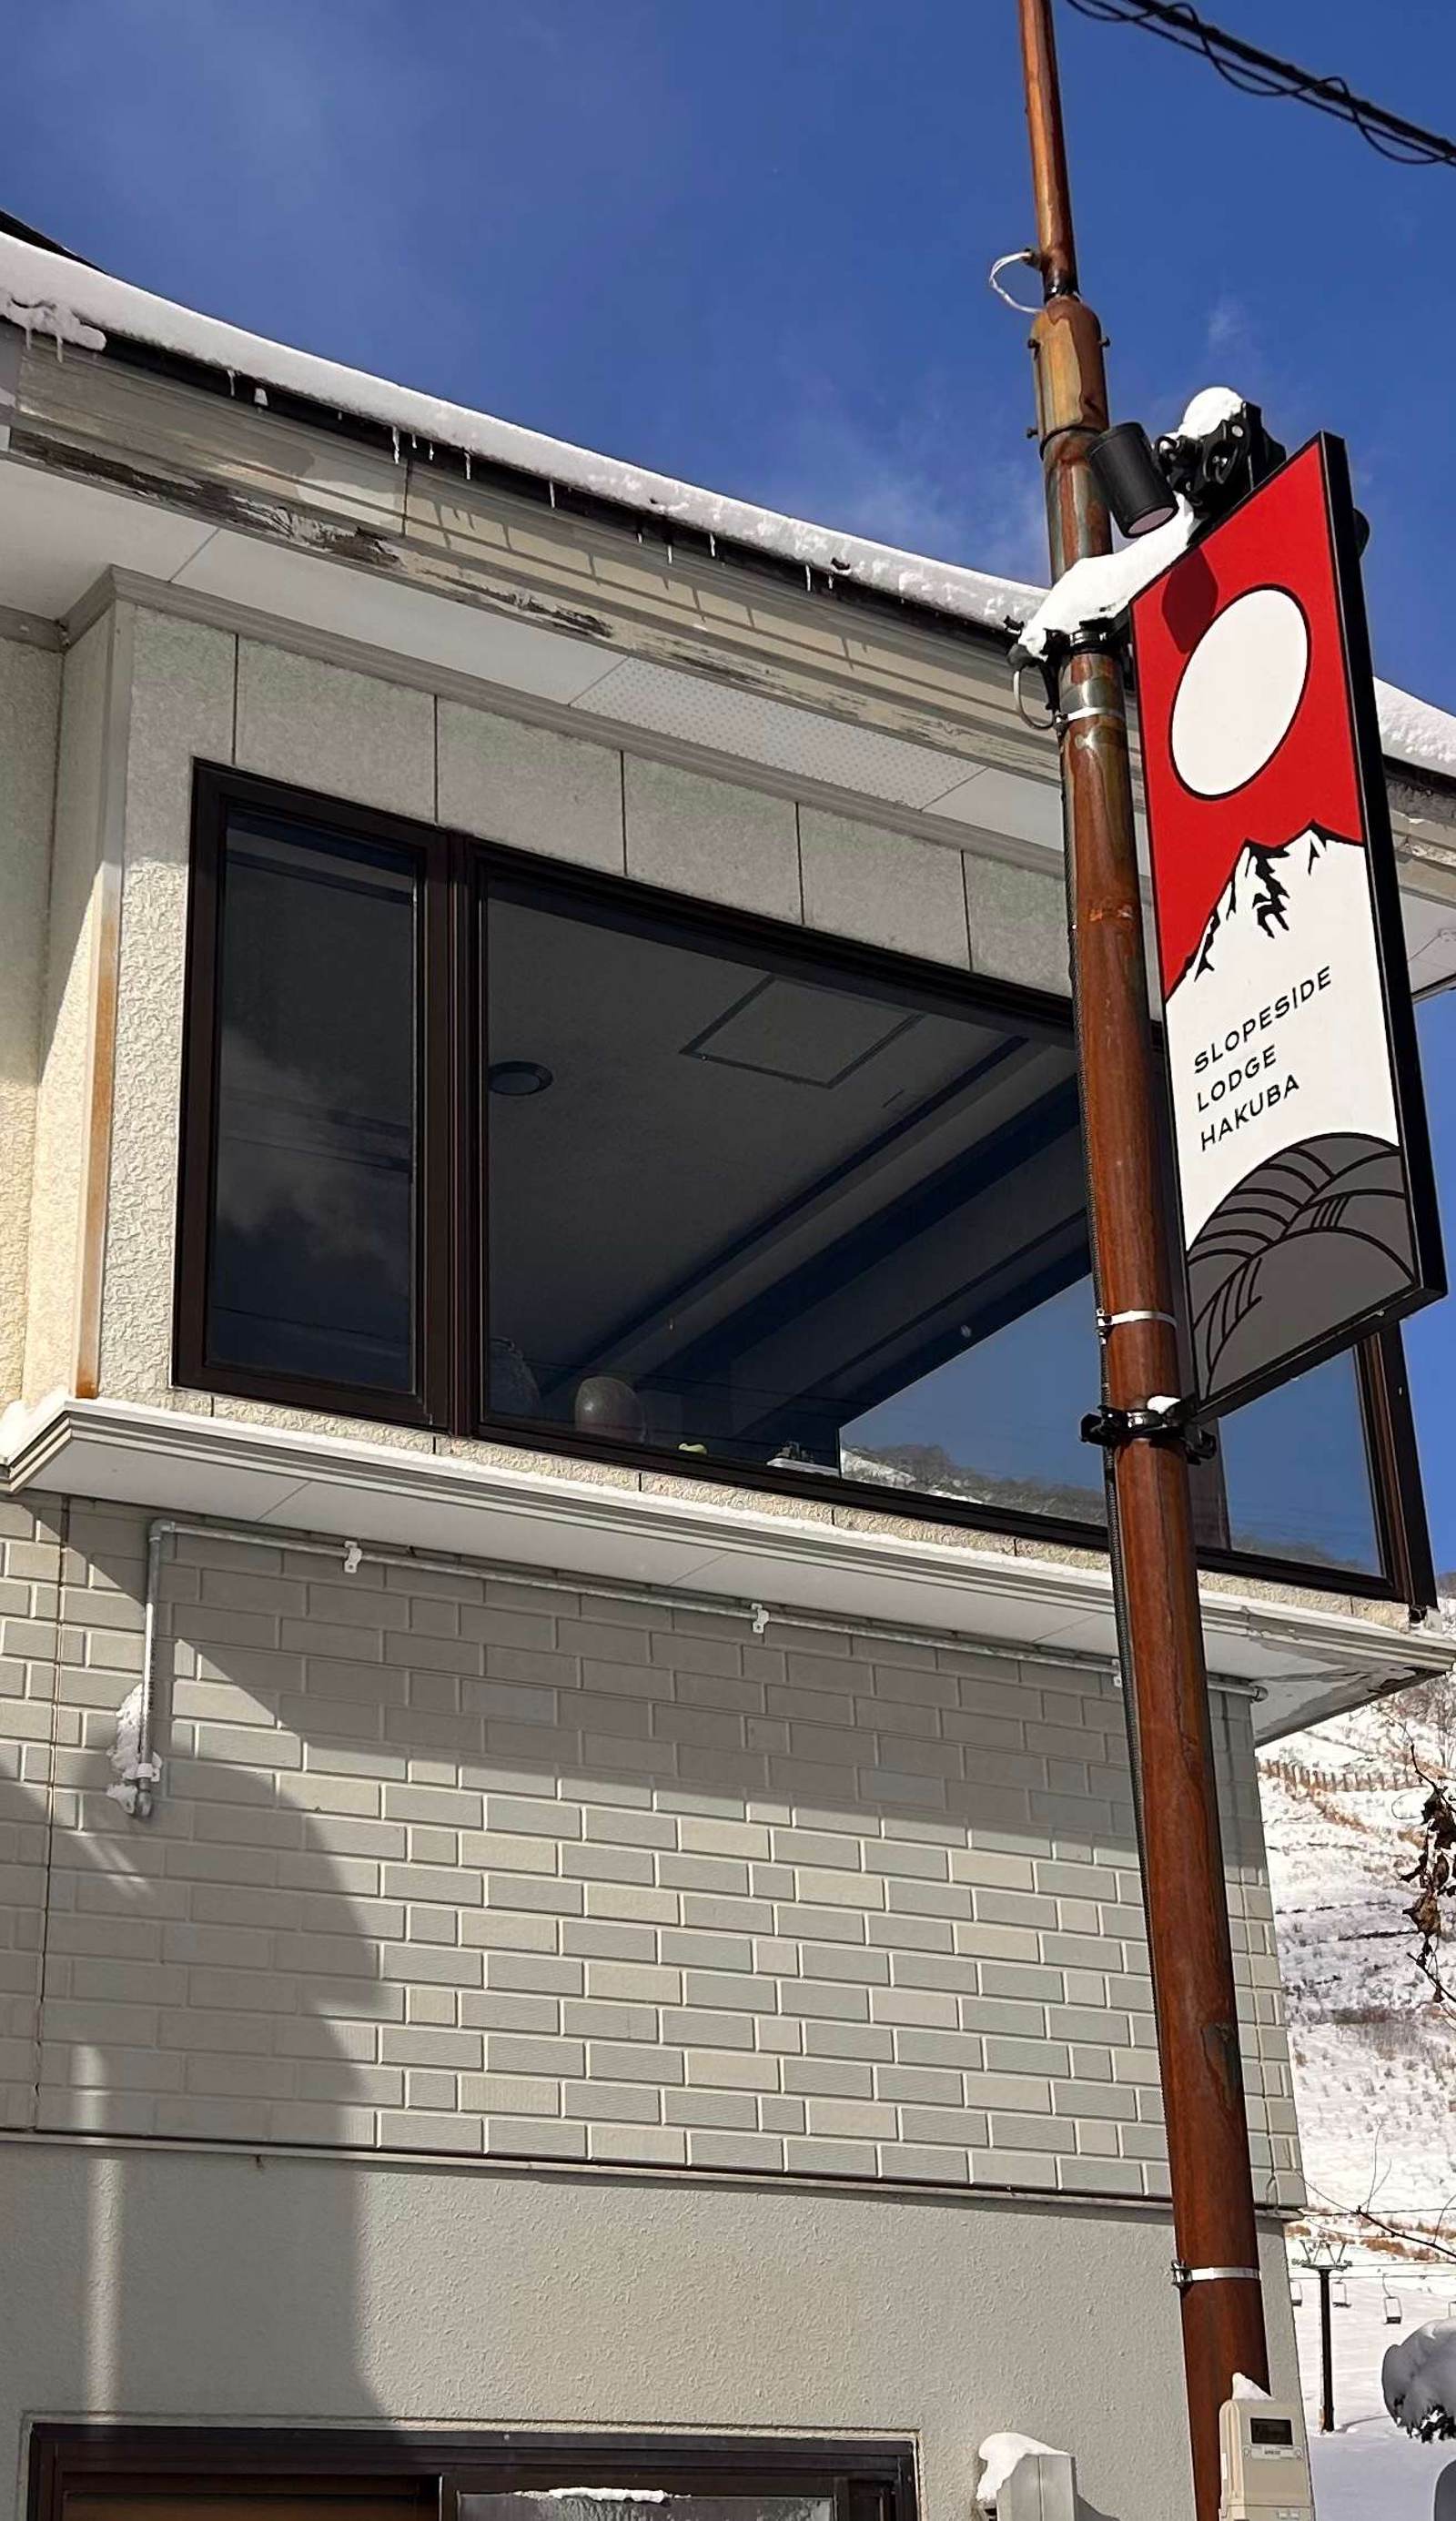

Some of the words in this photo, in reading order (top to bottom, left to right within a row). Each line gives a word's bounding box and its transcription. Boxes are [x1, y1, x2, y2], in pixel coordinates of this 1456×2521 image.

[1194, 966, 1331, 1074] SLOPESIDE
[1198, 1044, 1277, 1112] LODGE
[1200, 1074, 1299, 1152] HAKUBA
